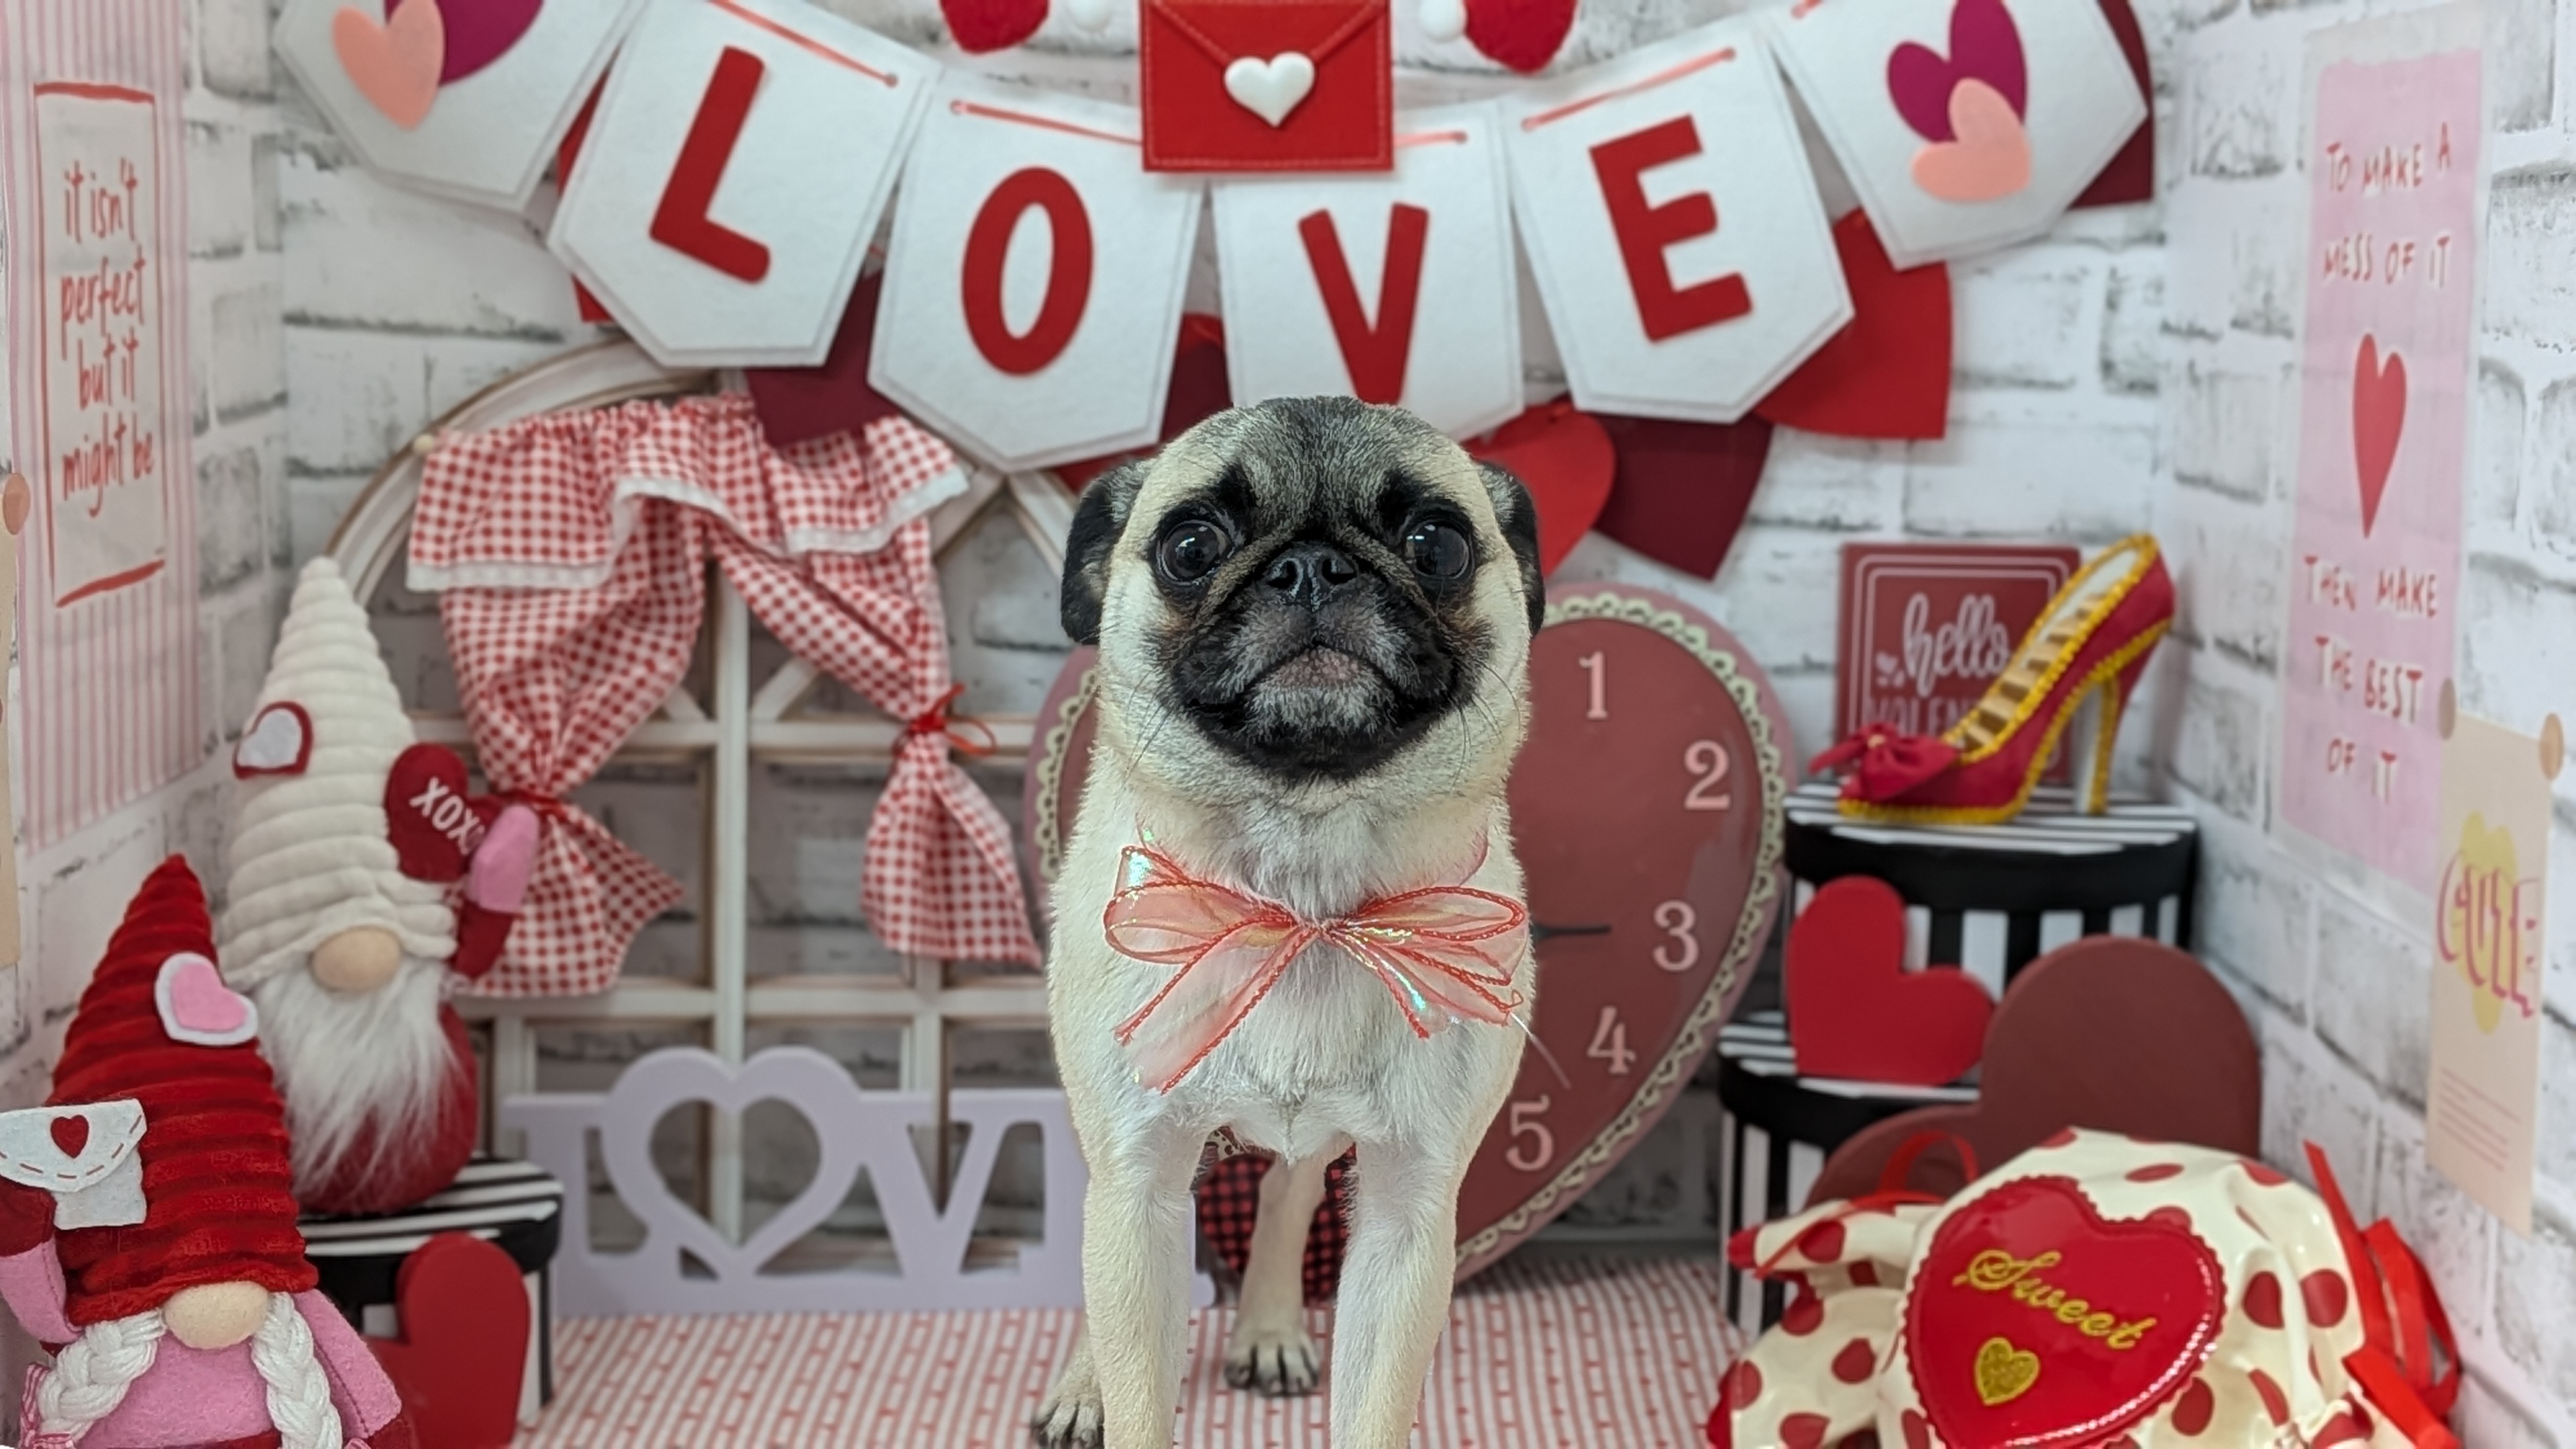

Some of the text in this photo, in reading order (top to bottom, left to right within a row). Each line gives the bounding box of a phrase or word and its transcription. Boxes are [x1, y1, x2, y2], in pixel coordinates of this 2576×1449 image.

[2326, 122, 2451, 194] TO MAKE A
[64, 157, 138, 244] it isn't
[649, 46, 1753, 405] LOVE
[2323, 233, 2450, 288] MESS OF IT
[61, 244, 146, 360] perfect
[77, 325, 139, 410] but it
[63, 411, 154, 517] might be
[2304, 555, 2436, 618] THEN MAKE
[1903, 592, 2010, 697] hello
[2315, 636, 2423, 724] THE BEST
[1579, 650, 1608, 719] 1
[1684, 740, 1731, 810] 2
[2328, 738, 2397, 804] OF IT
[409, 776, 486, 856] XOX
[1652, 900, 1699, 971] 3
[1587, 1006, 1636, 1075] 4
[1506, 1095, 1554, 1171] 5
[1952, 1249, 2157, 1350] Sweet
